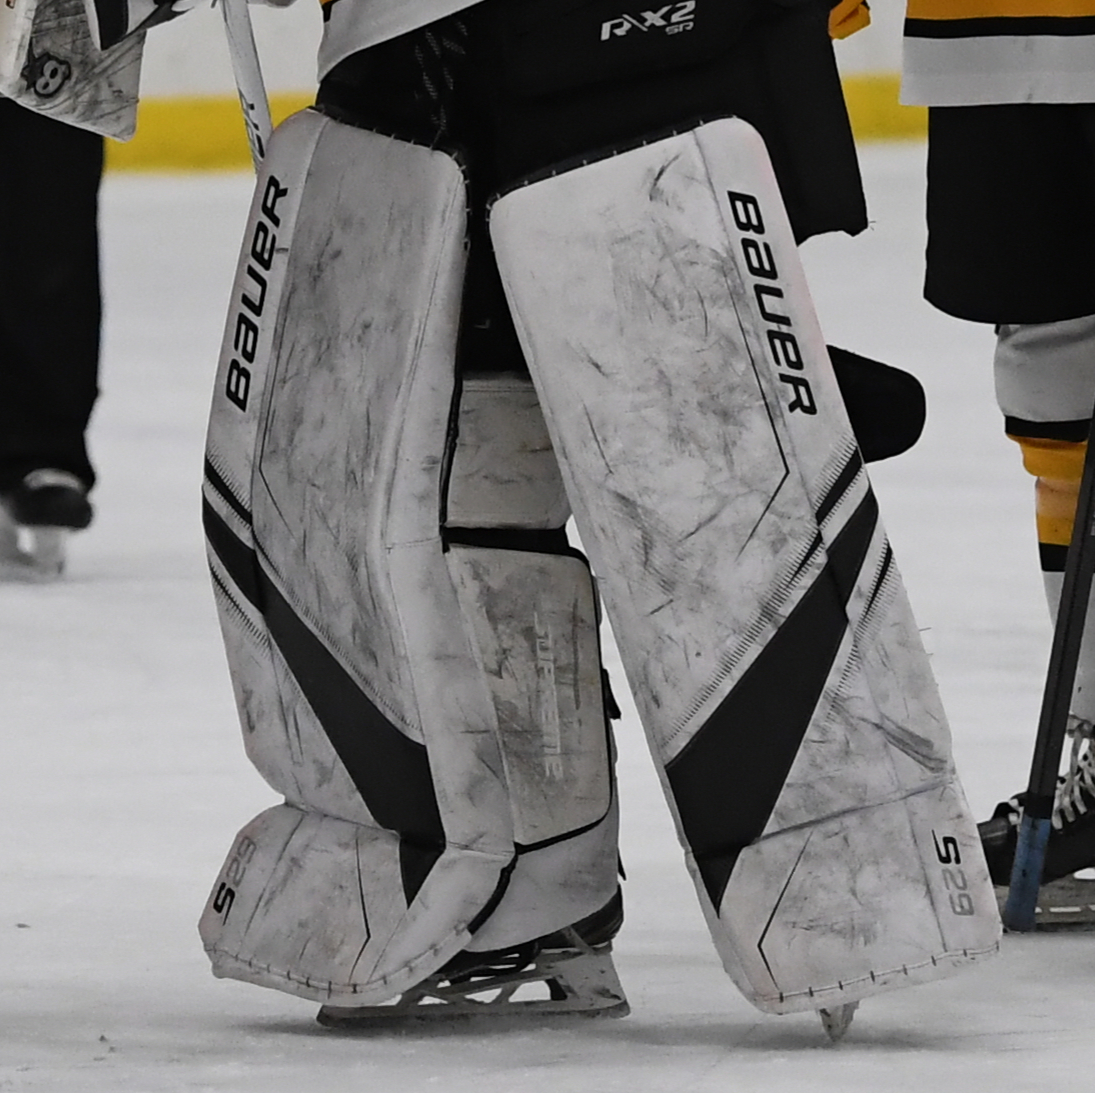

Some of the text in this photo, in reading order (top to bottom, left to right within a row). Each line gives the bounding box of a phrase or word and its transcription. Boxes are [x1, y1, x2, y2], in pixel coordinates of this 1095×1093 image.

[225, 174, 289, 413] BAUER
[727, 190, 818, 416] BAUER
[212, 836, 257, 925] S29
[931, 829, 974, 916] S29
